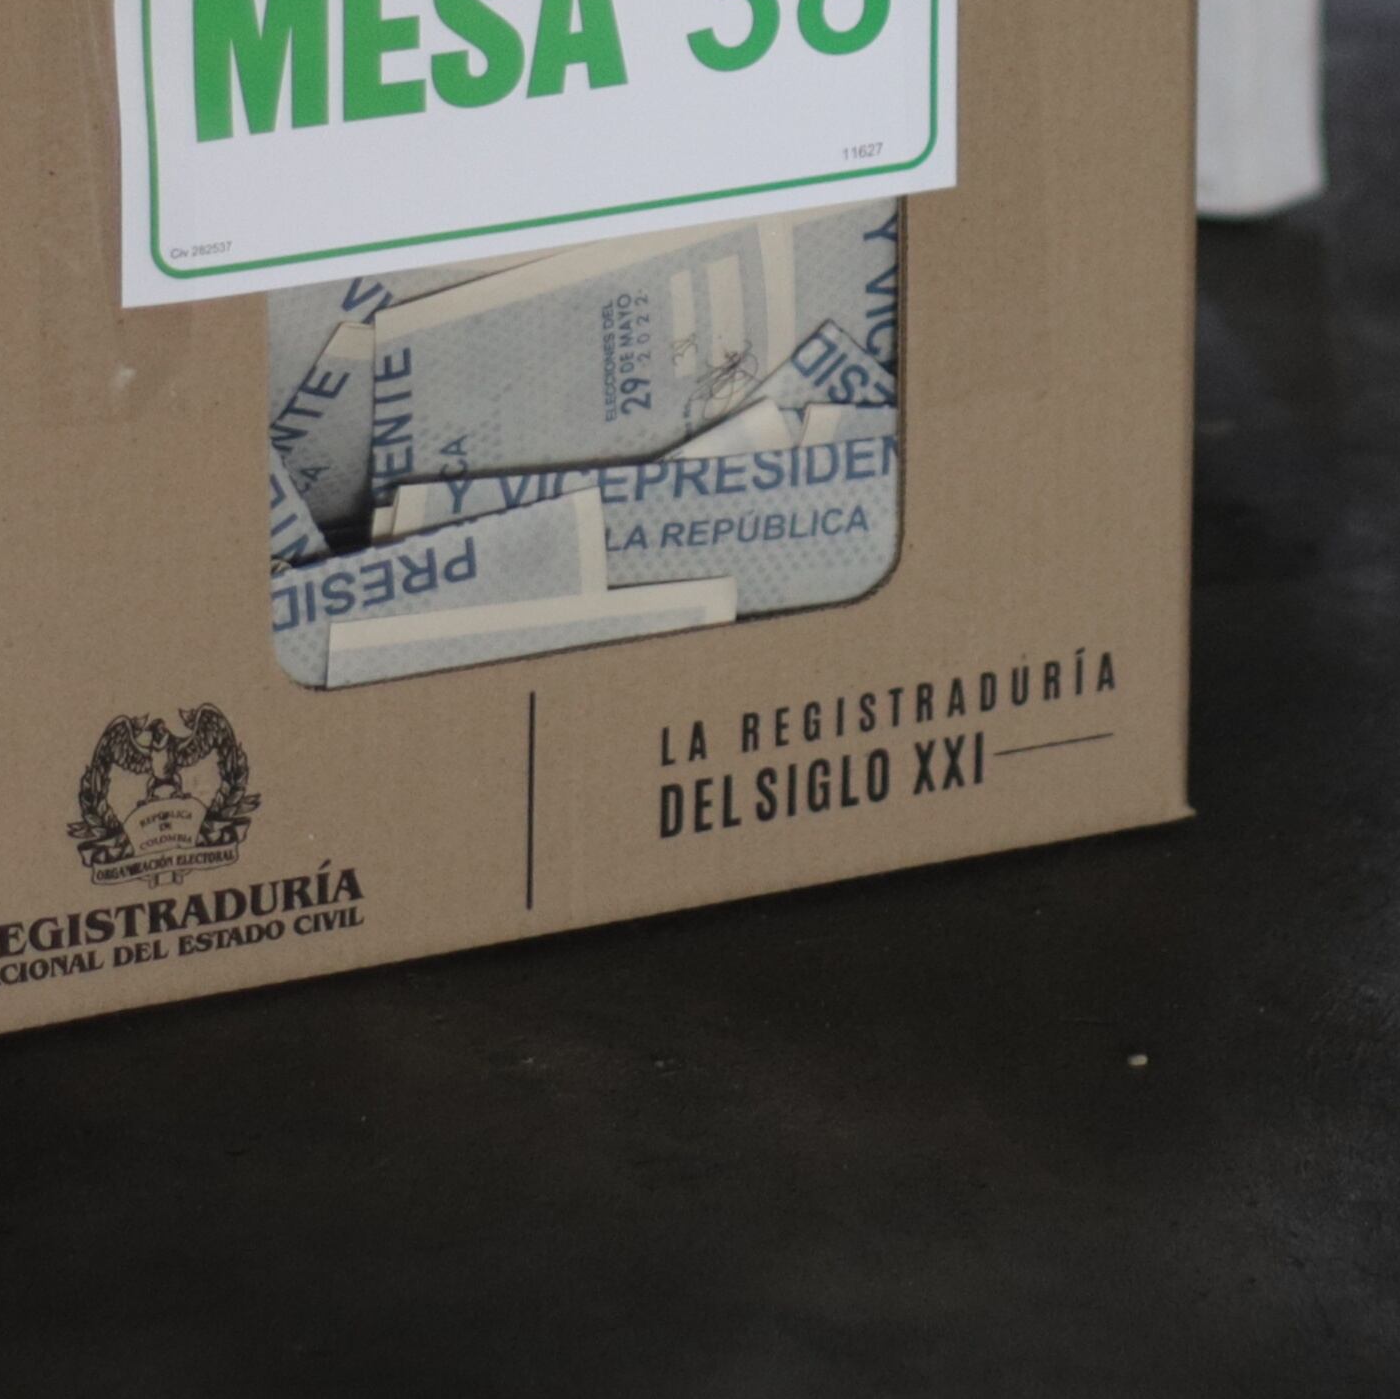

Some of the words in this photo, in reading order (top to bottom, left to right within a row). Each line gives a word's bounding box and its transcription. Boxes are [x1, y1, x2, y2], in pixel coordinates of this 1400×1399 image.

[842, 141, 884, 160] 11627
[602, 299, 614, 330] DEL
[617, 293, 634, 348] MAYO
[603, 333, 617, 423] ELECCIONES
[619, 352, 635, 374] DE
[620, 377, 652, 415] 29
[604, 522, 649, 552] LA
[661, 505, 870, 548] REPÚBLICA
[272, 535, 478, 633] PRESID
[661, 720, 707, 767] LA
[741, 647, 1116, 754] REGISTRADURÍA
[660, 774, 742, 840] DEL
[755, 747, 890, 822] SIGLO
[913, 731, 985, 795] XXI
[113, 939, 169, 968] DEL
[177, 919, 286, 956] ESTADO
[293, 906, 364, 935] CIVIL
